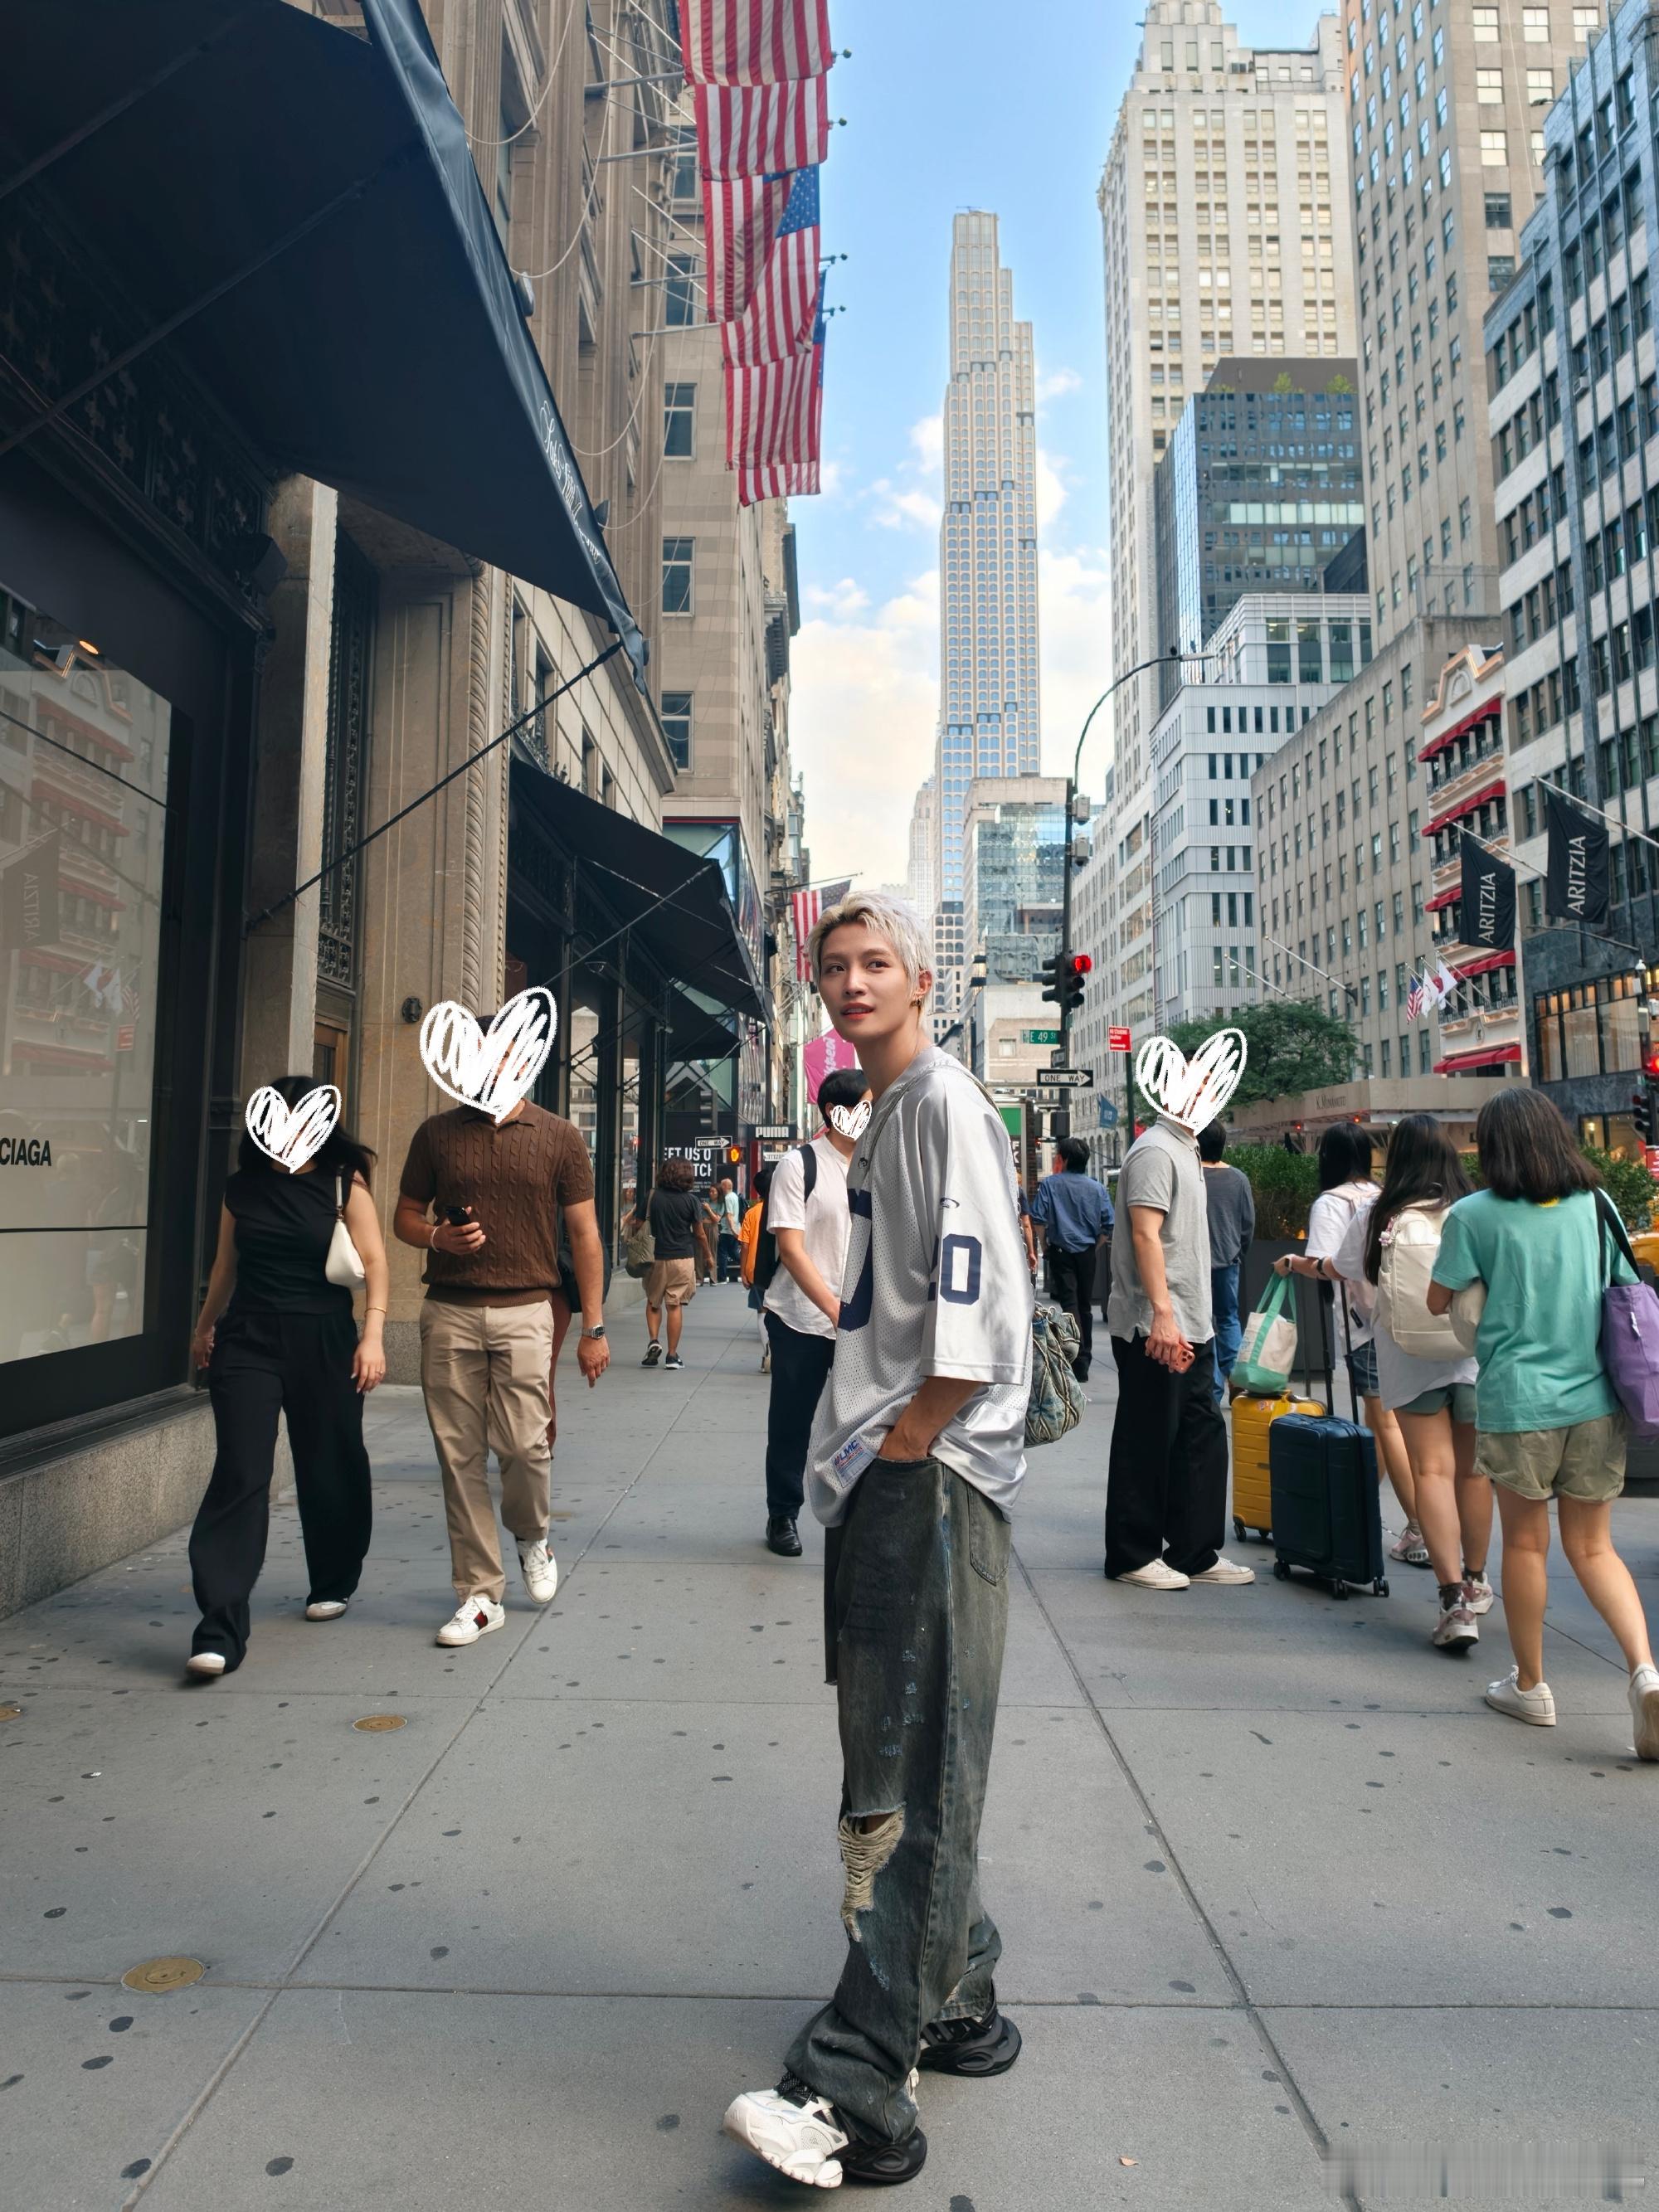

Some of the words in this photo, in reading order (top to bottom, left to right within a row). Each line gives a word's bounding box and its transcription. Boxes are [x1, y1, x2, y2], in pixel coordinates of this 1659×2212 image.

[1567, 836, 1586, 916] ARITZIA
[1478, 872, 1496, 944] ARITZIA
[1030, 1031, 1035, 1043] E
[1038, 1031, 1048, 1043] 49
[1044, 1074, 1061, 1082] ONE
[1068, 1074, 1085, 1082] WAY
[756, 1126, 789, 1138] PUMA
[684, 1147, 701, 1161] US
[839, 1440, 859, 1460] LMC
